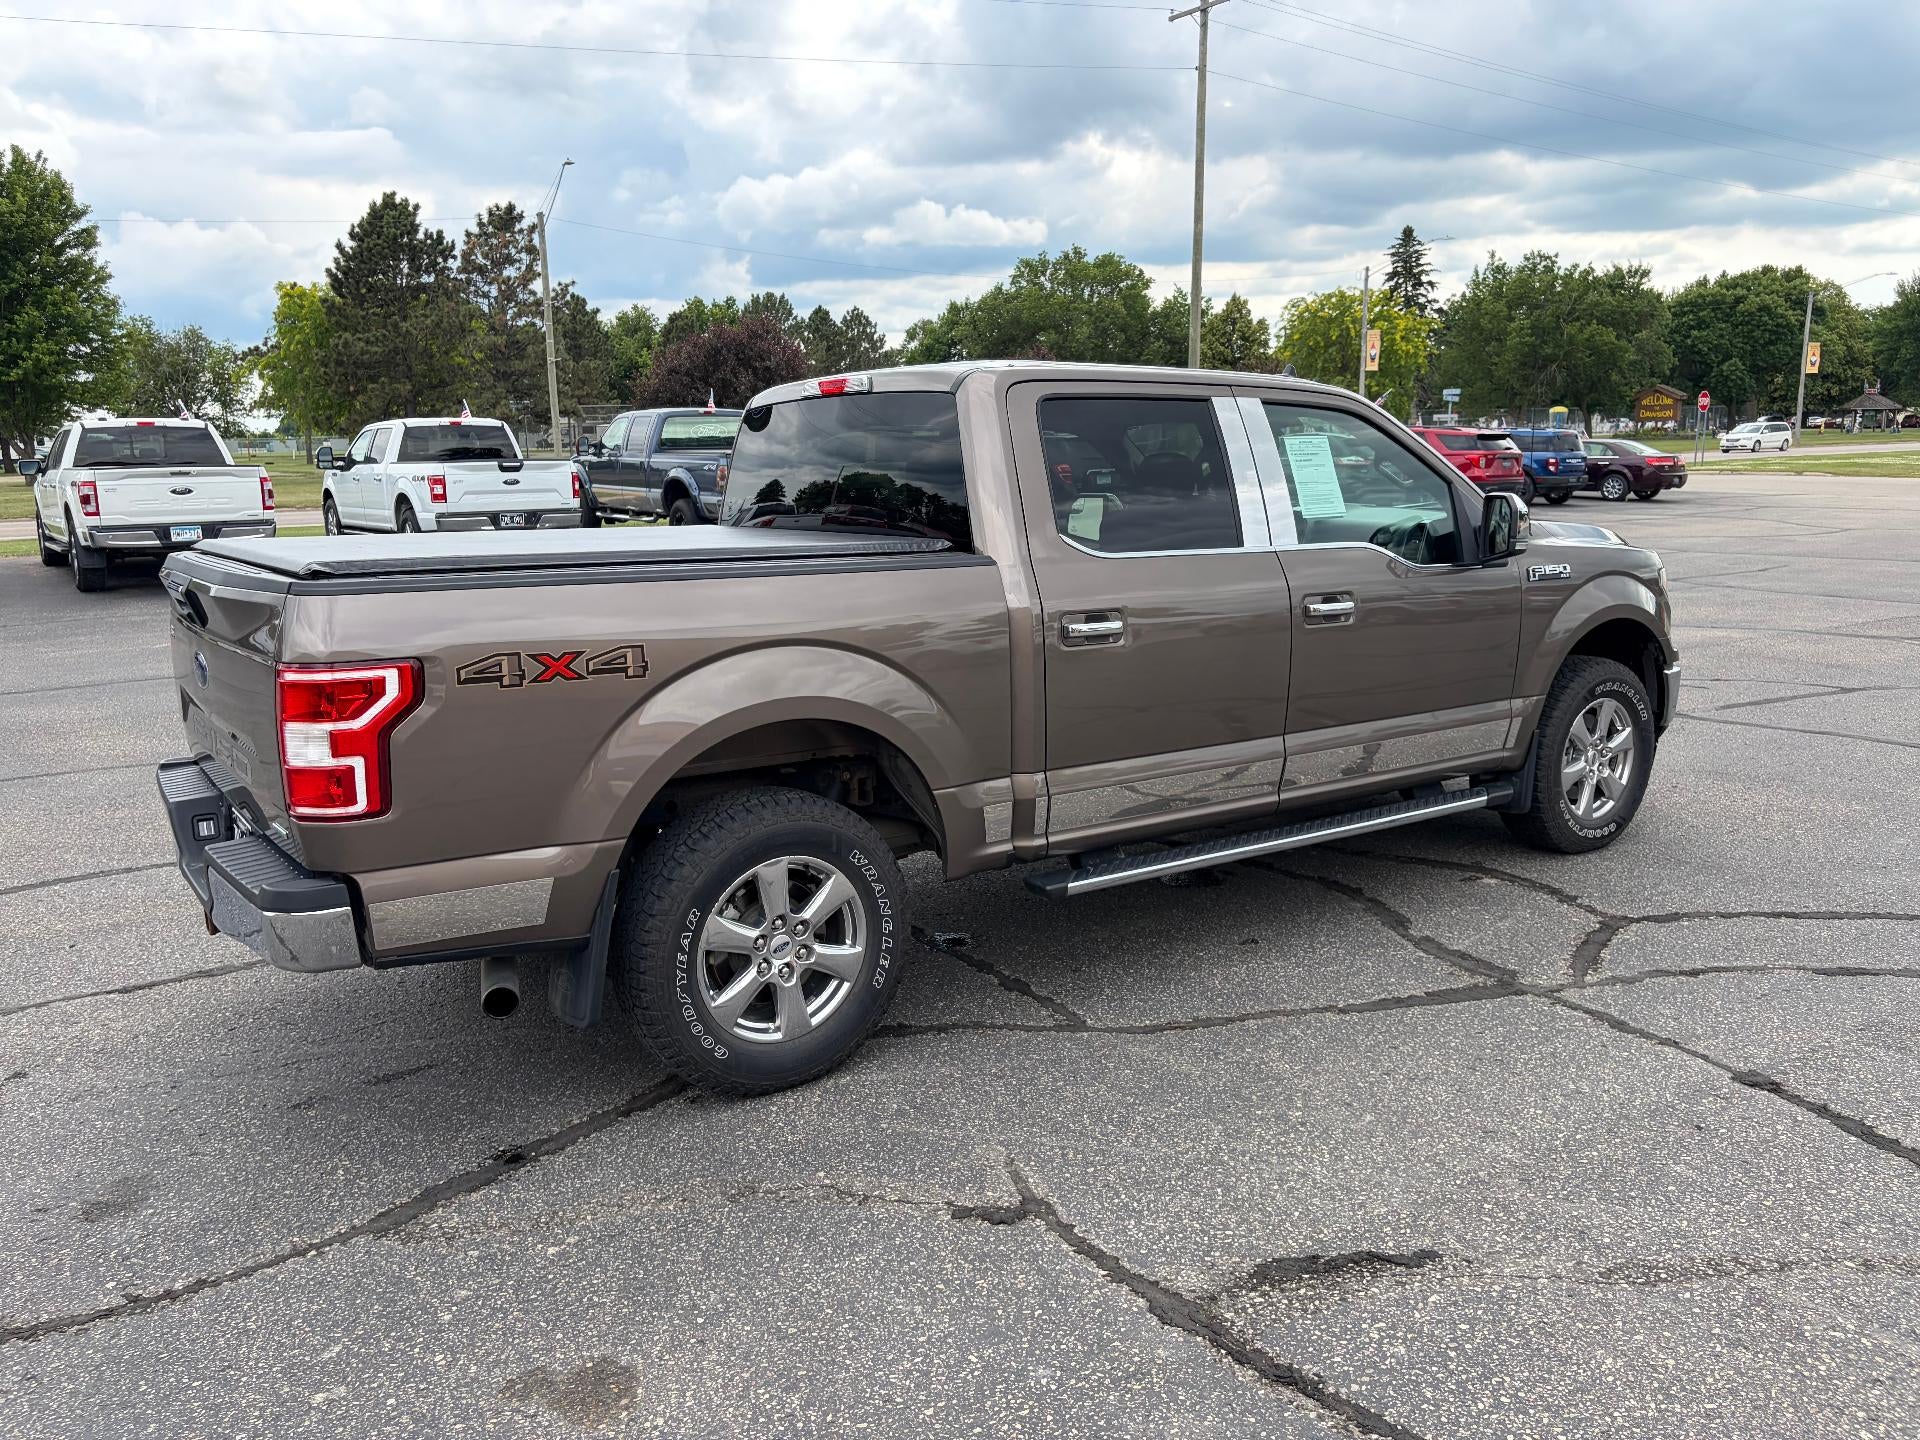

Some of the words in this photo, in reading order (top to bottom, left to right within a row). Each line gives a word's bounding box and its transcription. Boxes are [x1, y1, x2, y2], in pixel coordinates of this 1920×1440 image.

[1641, 393, 1674, 406] WELCOME
[1698, 397, 1710, 405] STOP
[1595, 681, 1648, 721] WRANGLER
[1559, 800, 1616, 838] GOODYEAR
[849, 849, 893, 989] WRANGLER
[676, 908, 729, 1059] GOODYEAR
